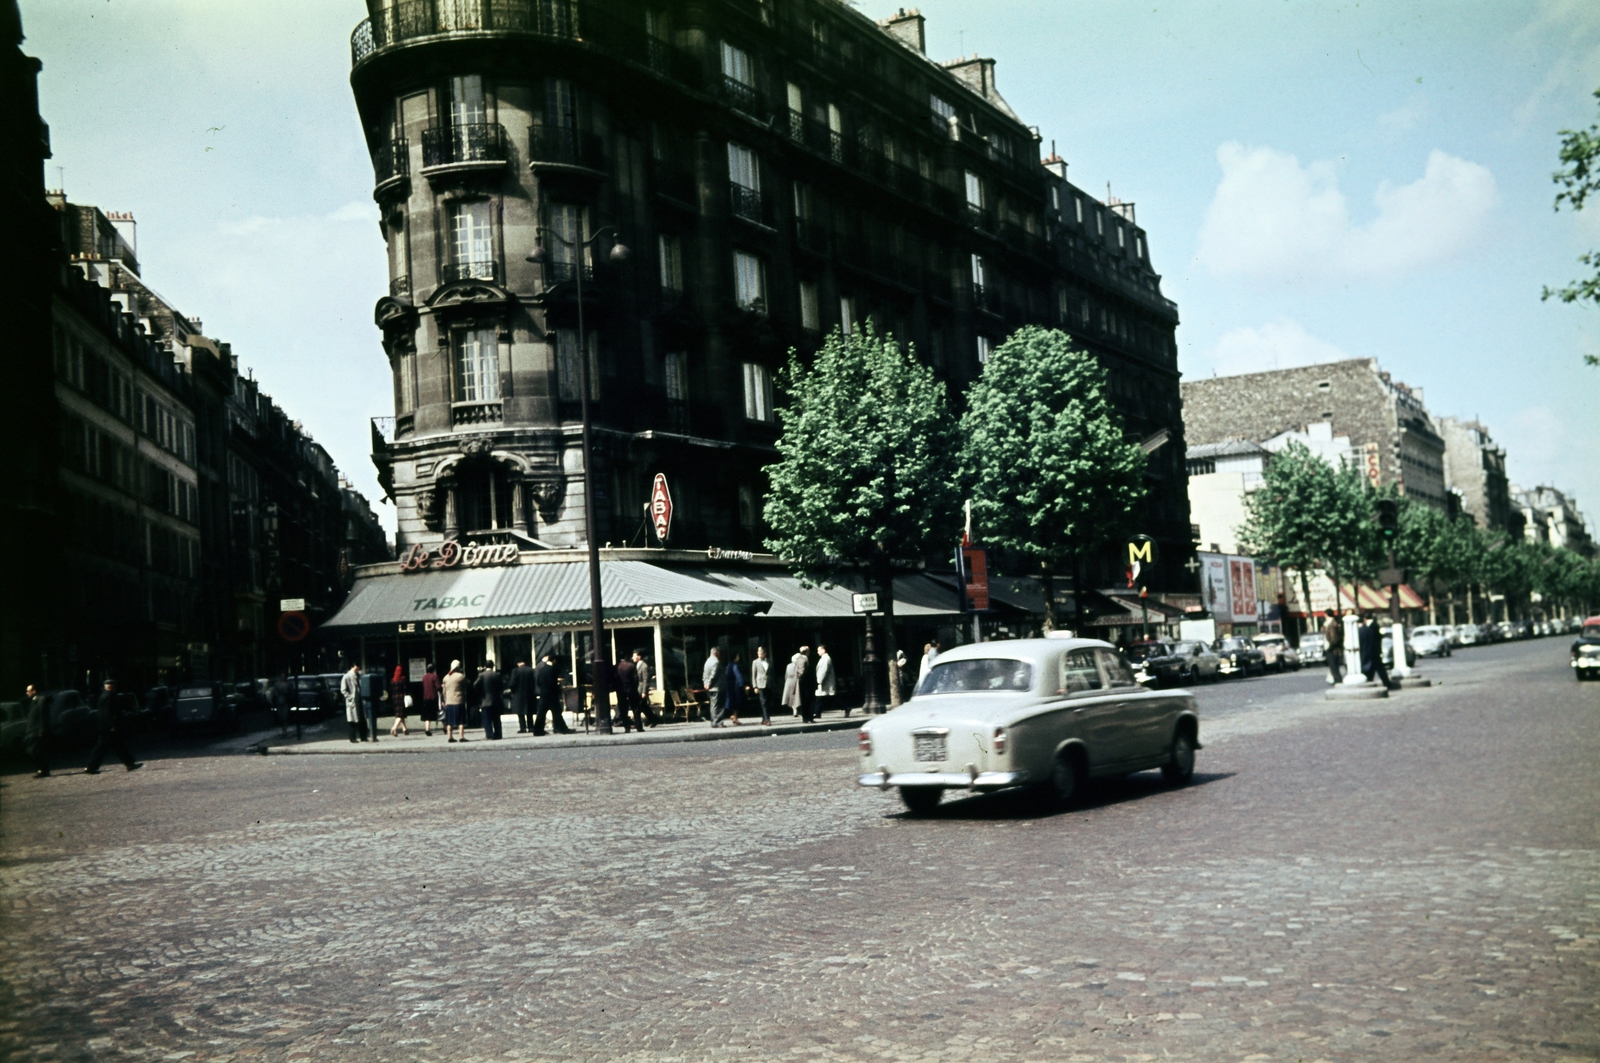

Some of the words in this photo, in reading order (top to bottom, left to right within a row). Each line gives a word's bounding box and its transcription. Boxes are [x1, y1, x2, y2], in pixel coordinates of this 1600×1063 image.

[654, 477, 667, 539] TABAC
[400, 543, 429, 570] Le
[435, 540, 518, 567] Dôme
[1129, 541, 1151, 564] M
[413, 595, 485, 611] TABAC
[641, 604, 693, 617] TABAC
[398, 623, 415, 633] LE
[425, 619, 468, 631] DOME
